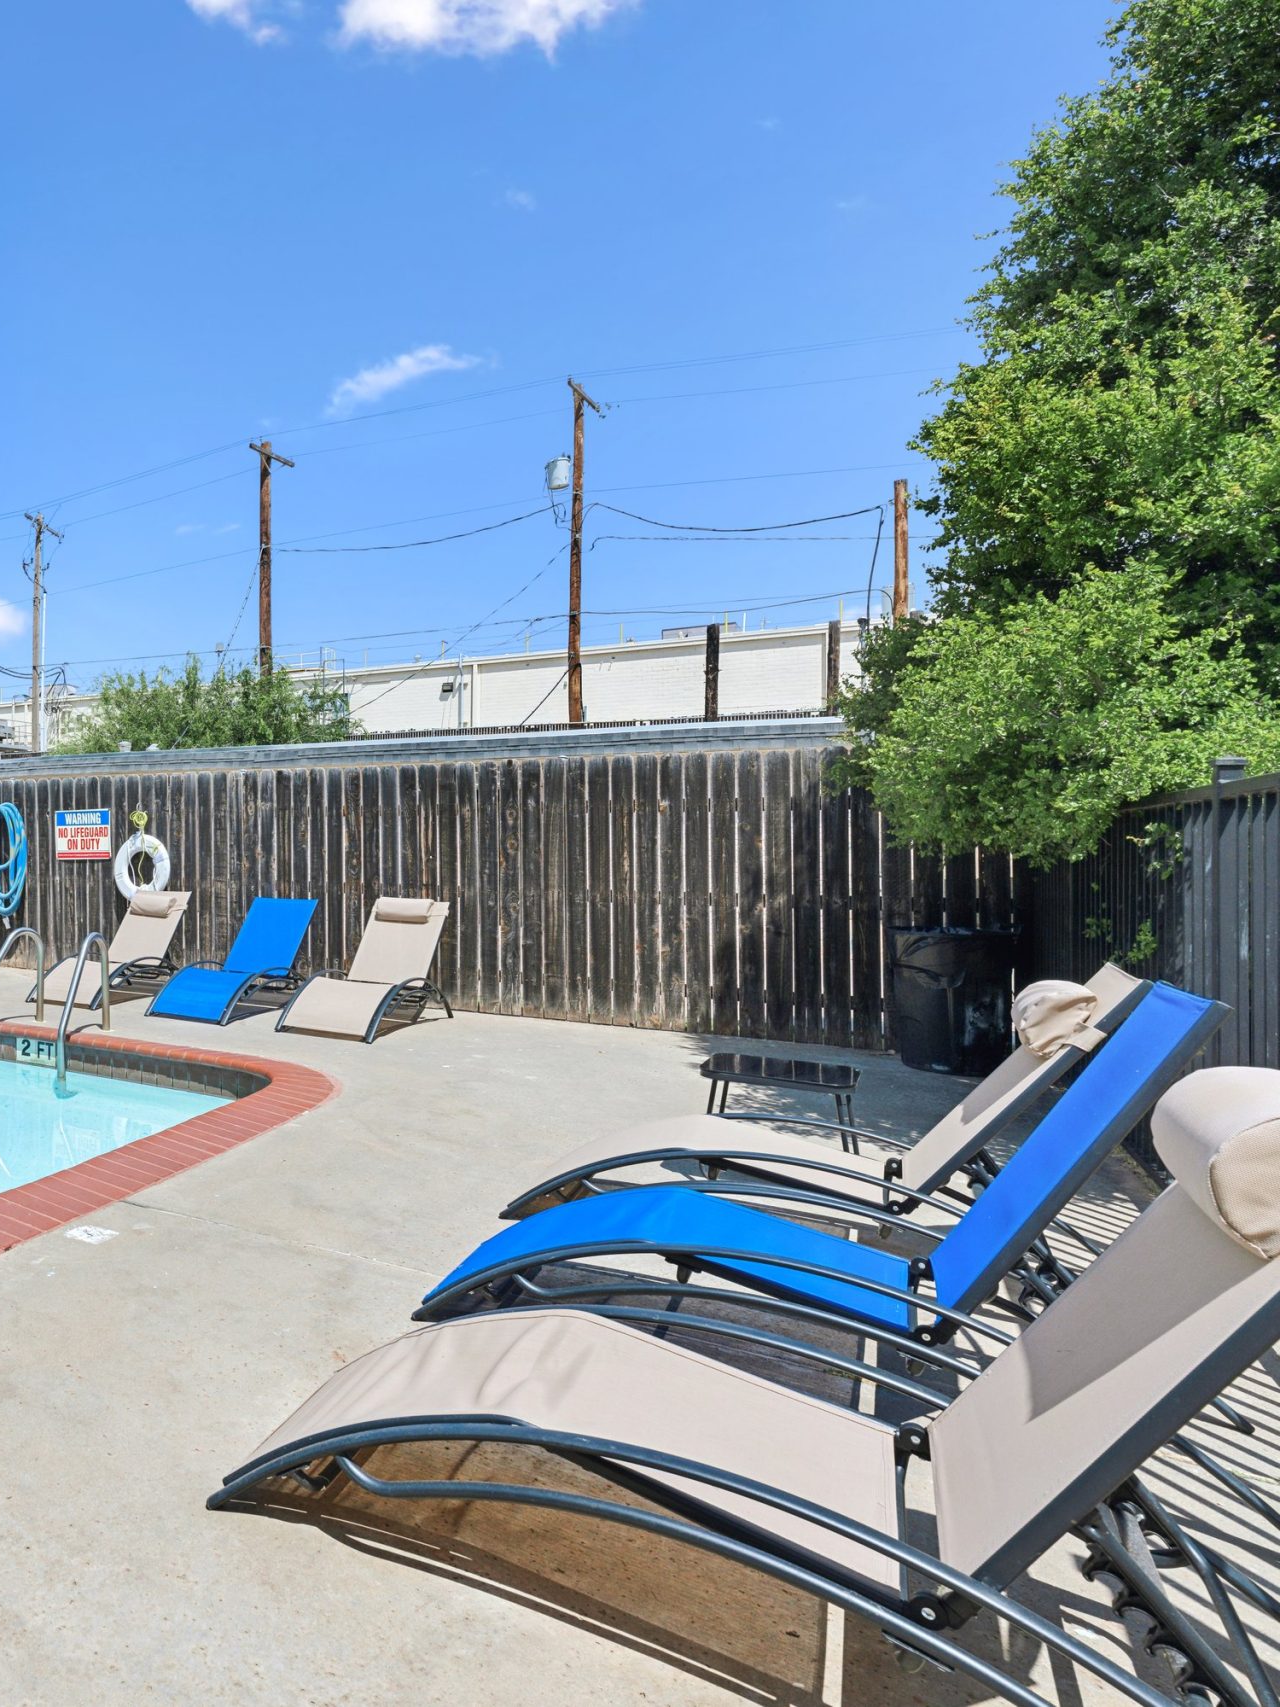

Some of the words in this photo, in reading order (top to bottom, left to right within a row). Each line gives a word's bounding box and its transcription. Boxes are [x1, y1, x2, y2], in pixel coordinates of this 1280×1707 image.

[64, 812, 102, 825] WARNING
[58, 828, 68, 838] NO
[71, 827, 108, 838] LIFEGUARD
[68, 839, 78, 850] ON
[81, 839, 100, 850] DUTY
[21, 1039, 31, 1057] 2
[37, 1041, 54, 1060] FT
